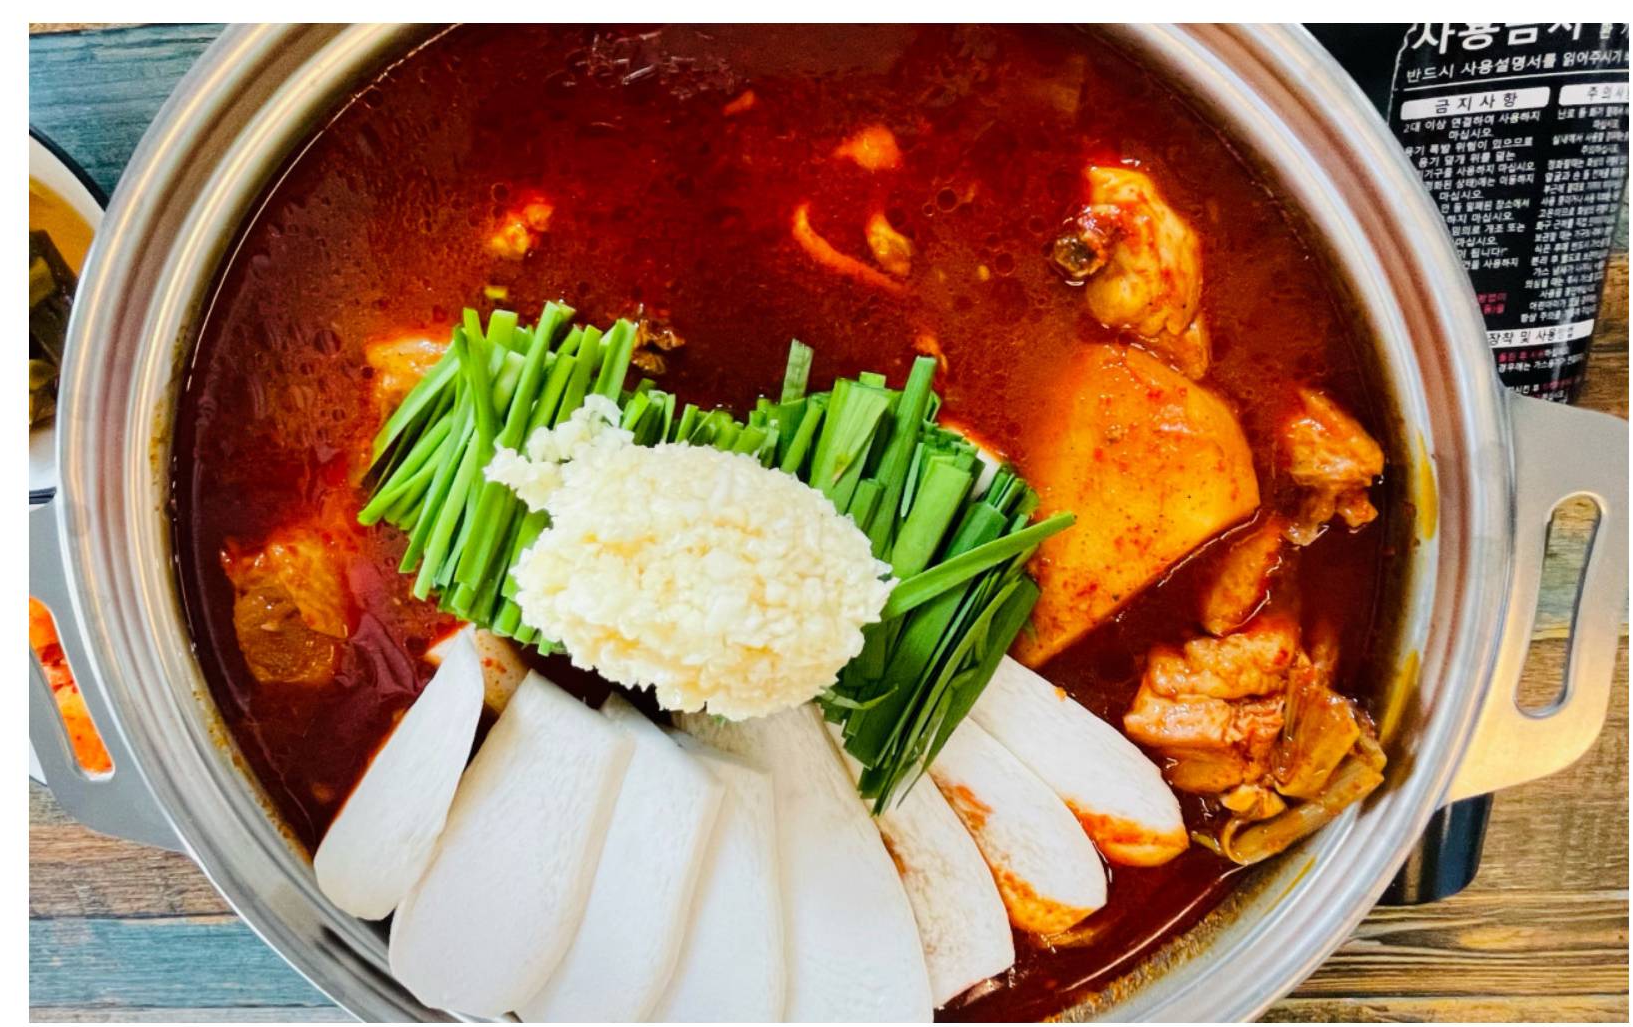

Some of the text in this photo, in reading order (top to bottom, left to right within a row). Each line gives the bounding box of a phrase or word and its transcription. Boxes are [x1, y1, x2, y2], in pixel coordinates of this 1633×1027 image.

[1406, 50, 1623, 84] 반드시 사용설명서를 읽어주시기
[1404, 110, 1541, 134] 2대 이상 연결하여 사용하지
[1456, 140, 1488, 153] 위험이
[1492, 136, 1533, 150] 있으므로
[1419, 157, 1440, 169] 용기
[1456, 164, 1495, 177] 사용하지
[1499, 174, 1535, 186] 이동하지
[1496, 198, 1530, 211] 장소에서
[1483, 257, 1519, 270] 사용하지
